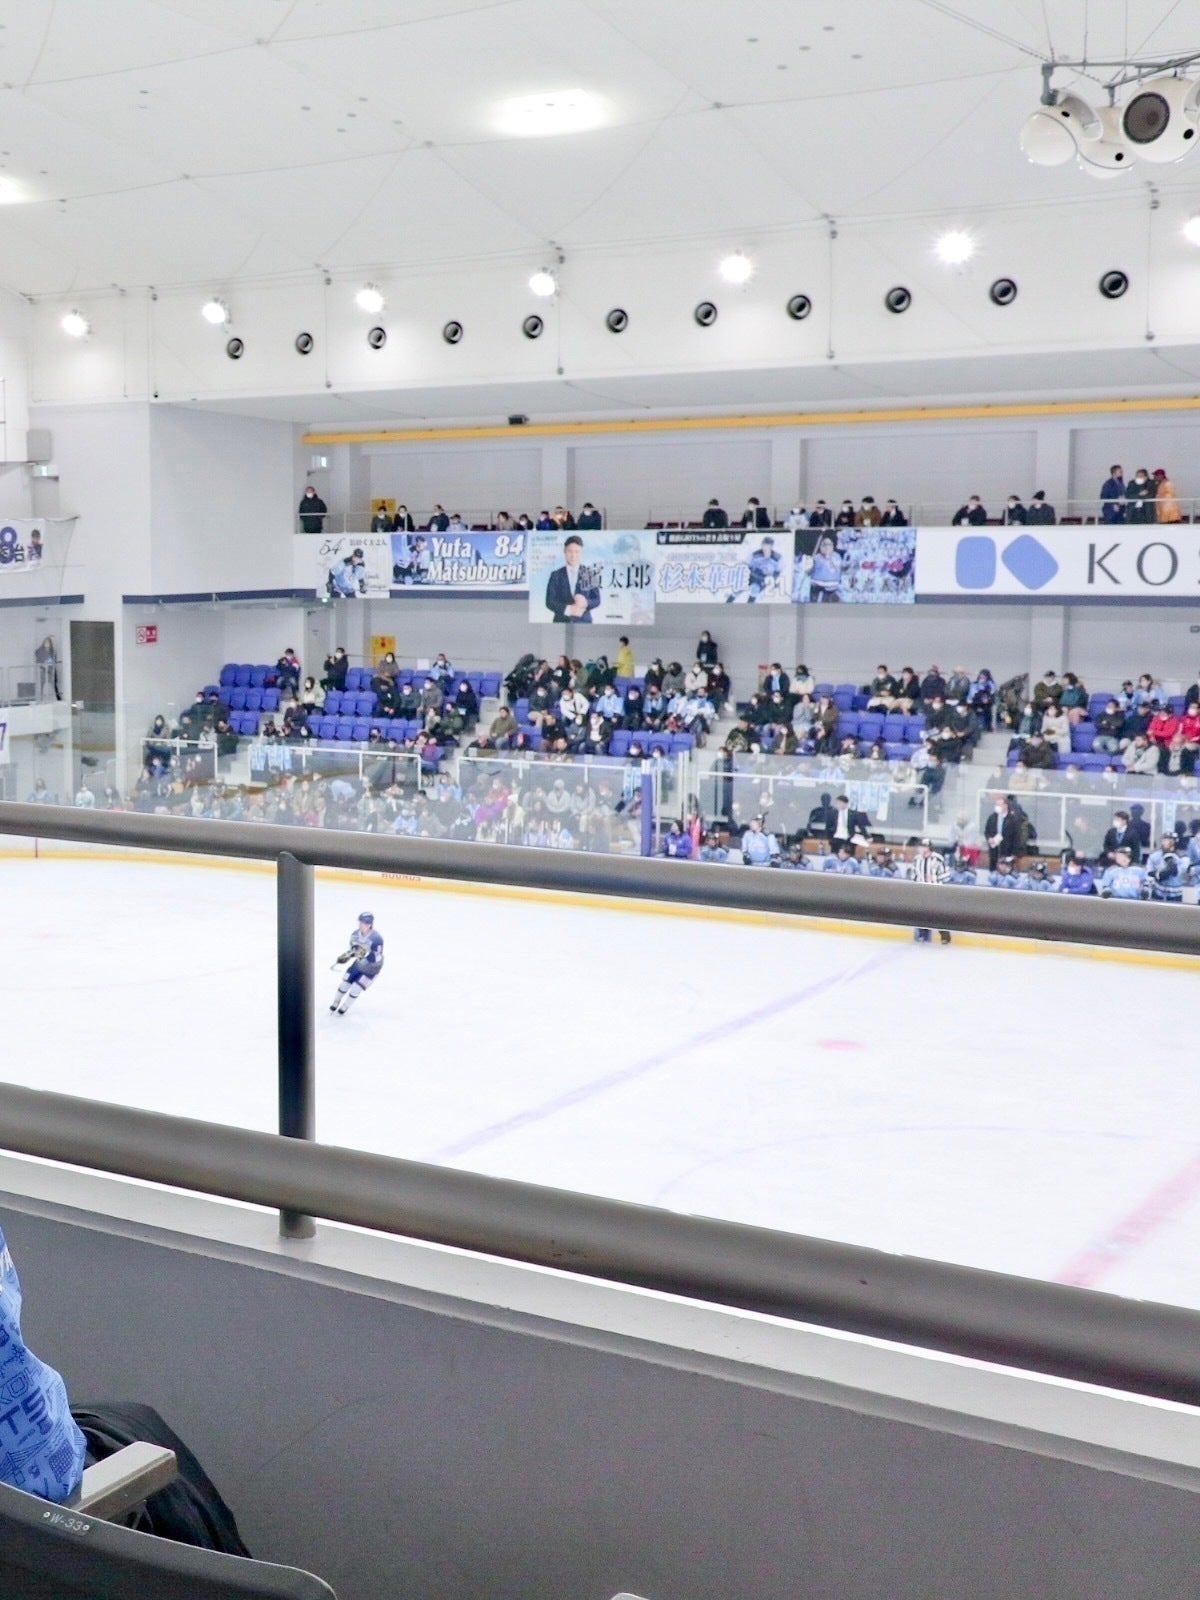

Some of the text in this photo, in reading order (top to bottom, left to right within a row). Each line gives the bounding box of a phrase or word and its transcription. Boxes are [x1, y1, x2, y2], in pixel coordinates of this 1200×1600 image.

[431, 537, 472, 558] Yuta
[494, 535, 524, 558] 84
[427, 559, 523, 582] Matsubuchi
[1088, 541, 1200, 586] KO
